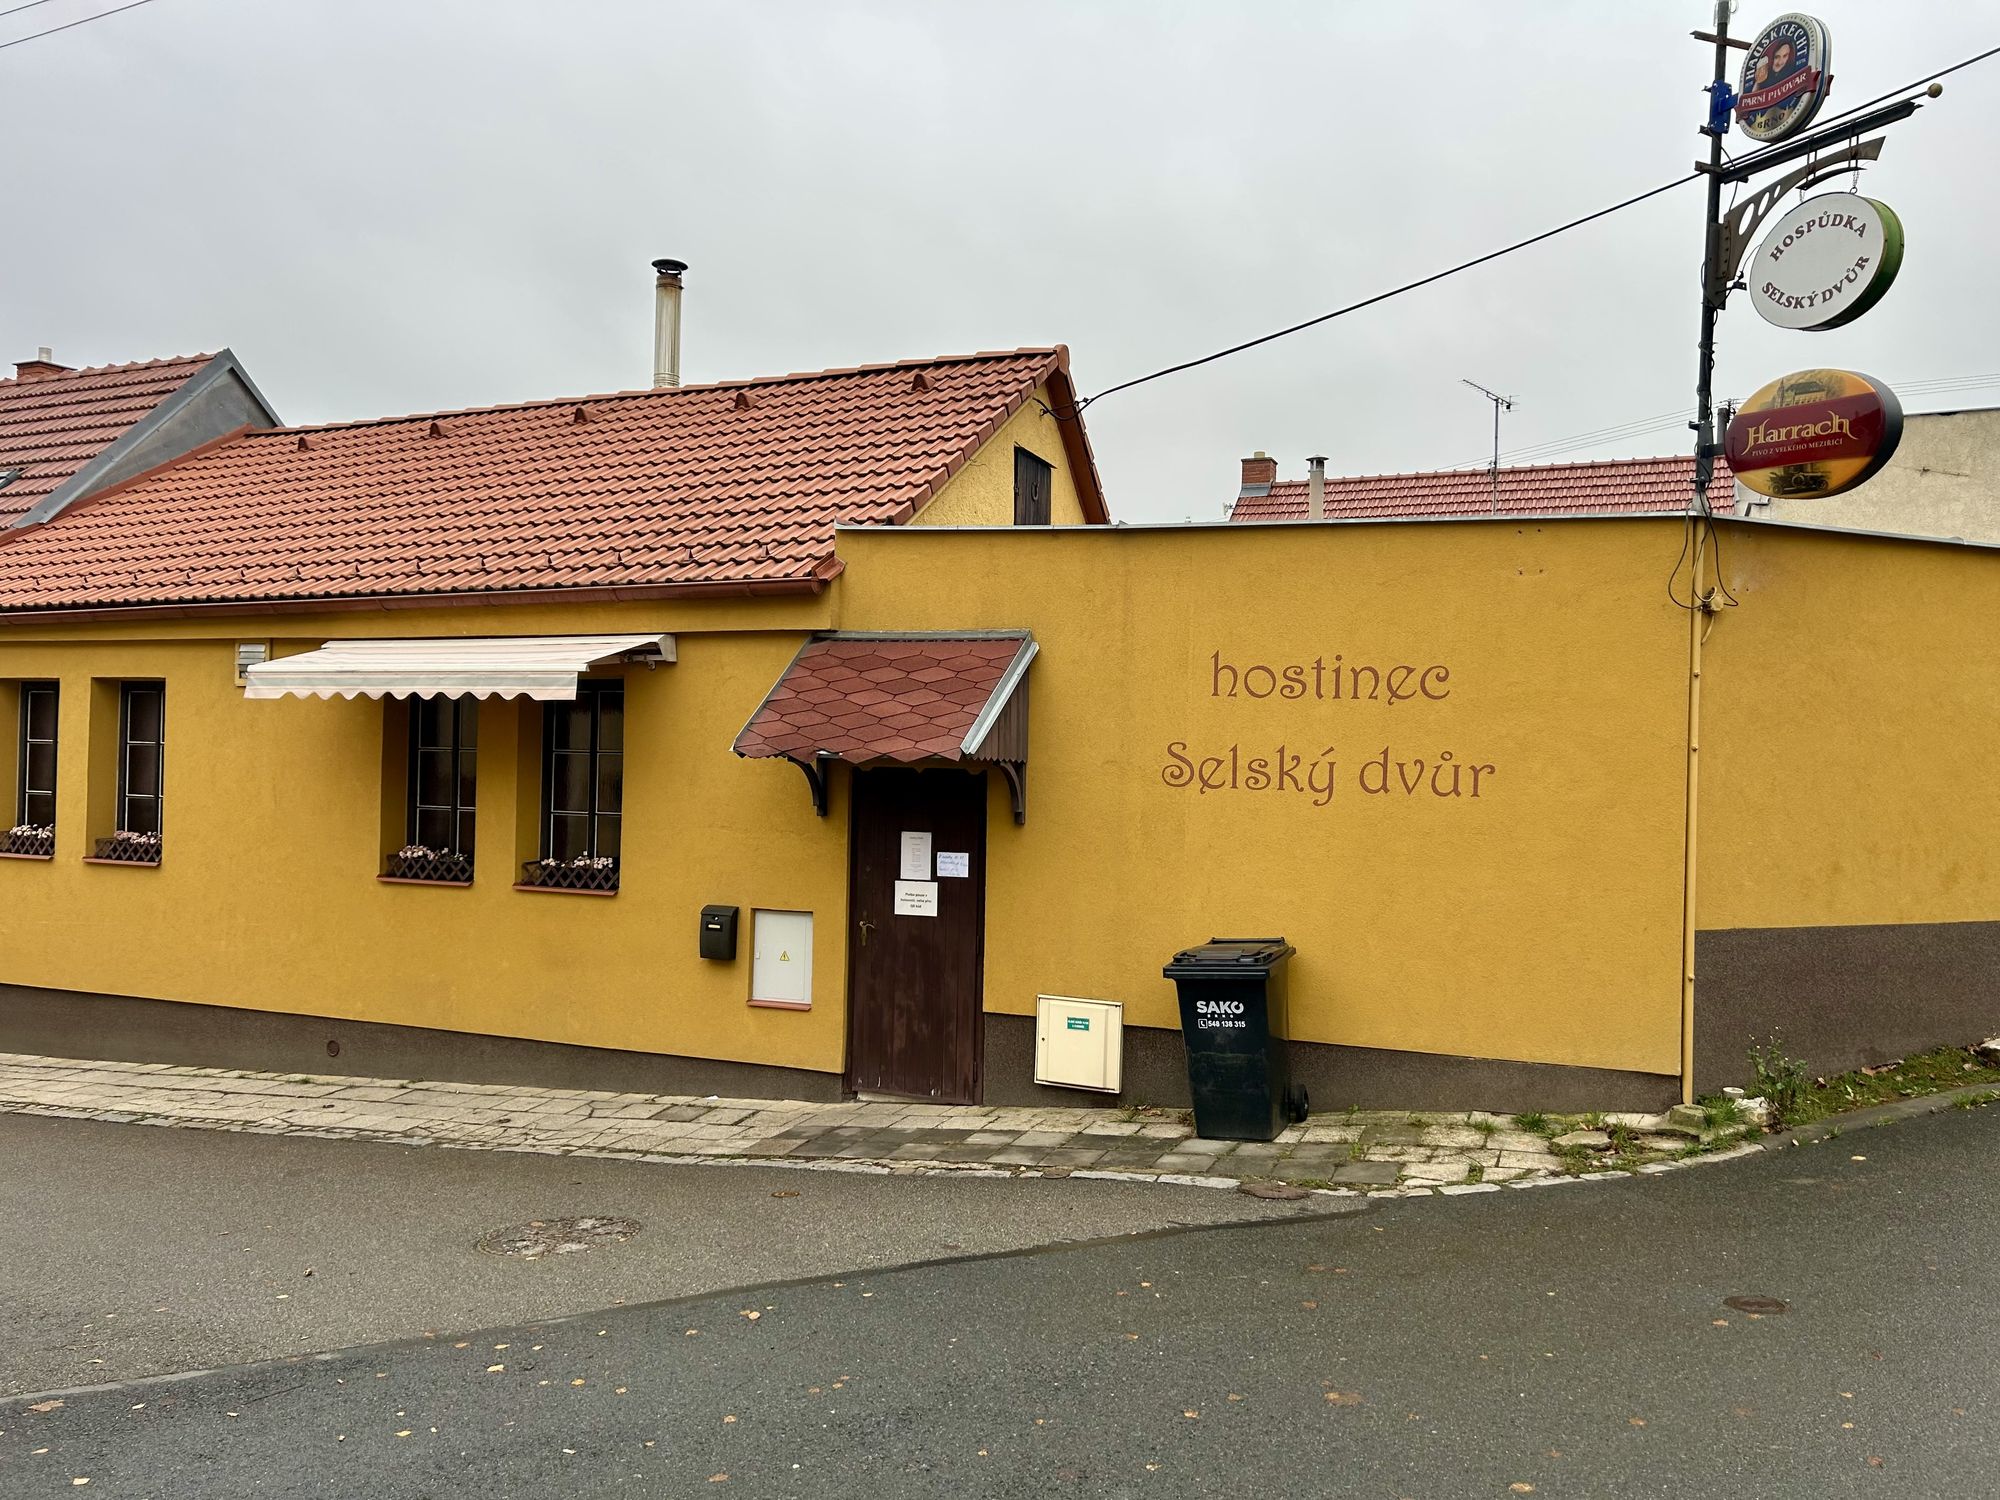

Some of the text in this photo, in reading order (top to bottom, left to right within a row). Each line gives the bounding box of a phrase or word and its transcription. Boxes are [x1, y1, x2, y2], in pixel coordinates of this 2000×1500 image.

[1768, 72, 1808, 102] PIVOVAR
[1769, 210, 1867, 262] HOSPŮDKA
[1761, 255, 1870, 310] SELSKÝ DVŮR
[1741, 410, 1859, 456] Harrach
[1210, 649, 1451, 706] hostinec
[1161, 741, 1496, 807] Selský dvůr
[1196, 1000, 1244, 1014] SAKO
[1221, 1020, 1233, 1028] 138
